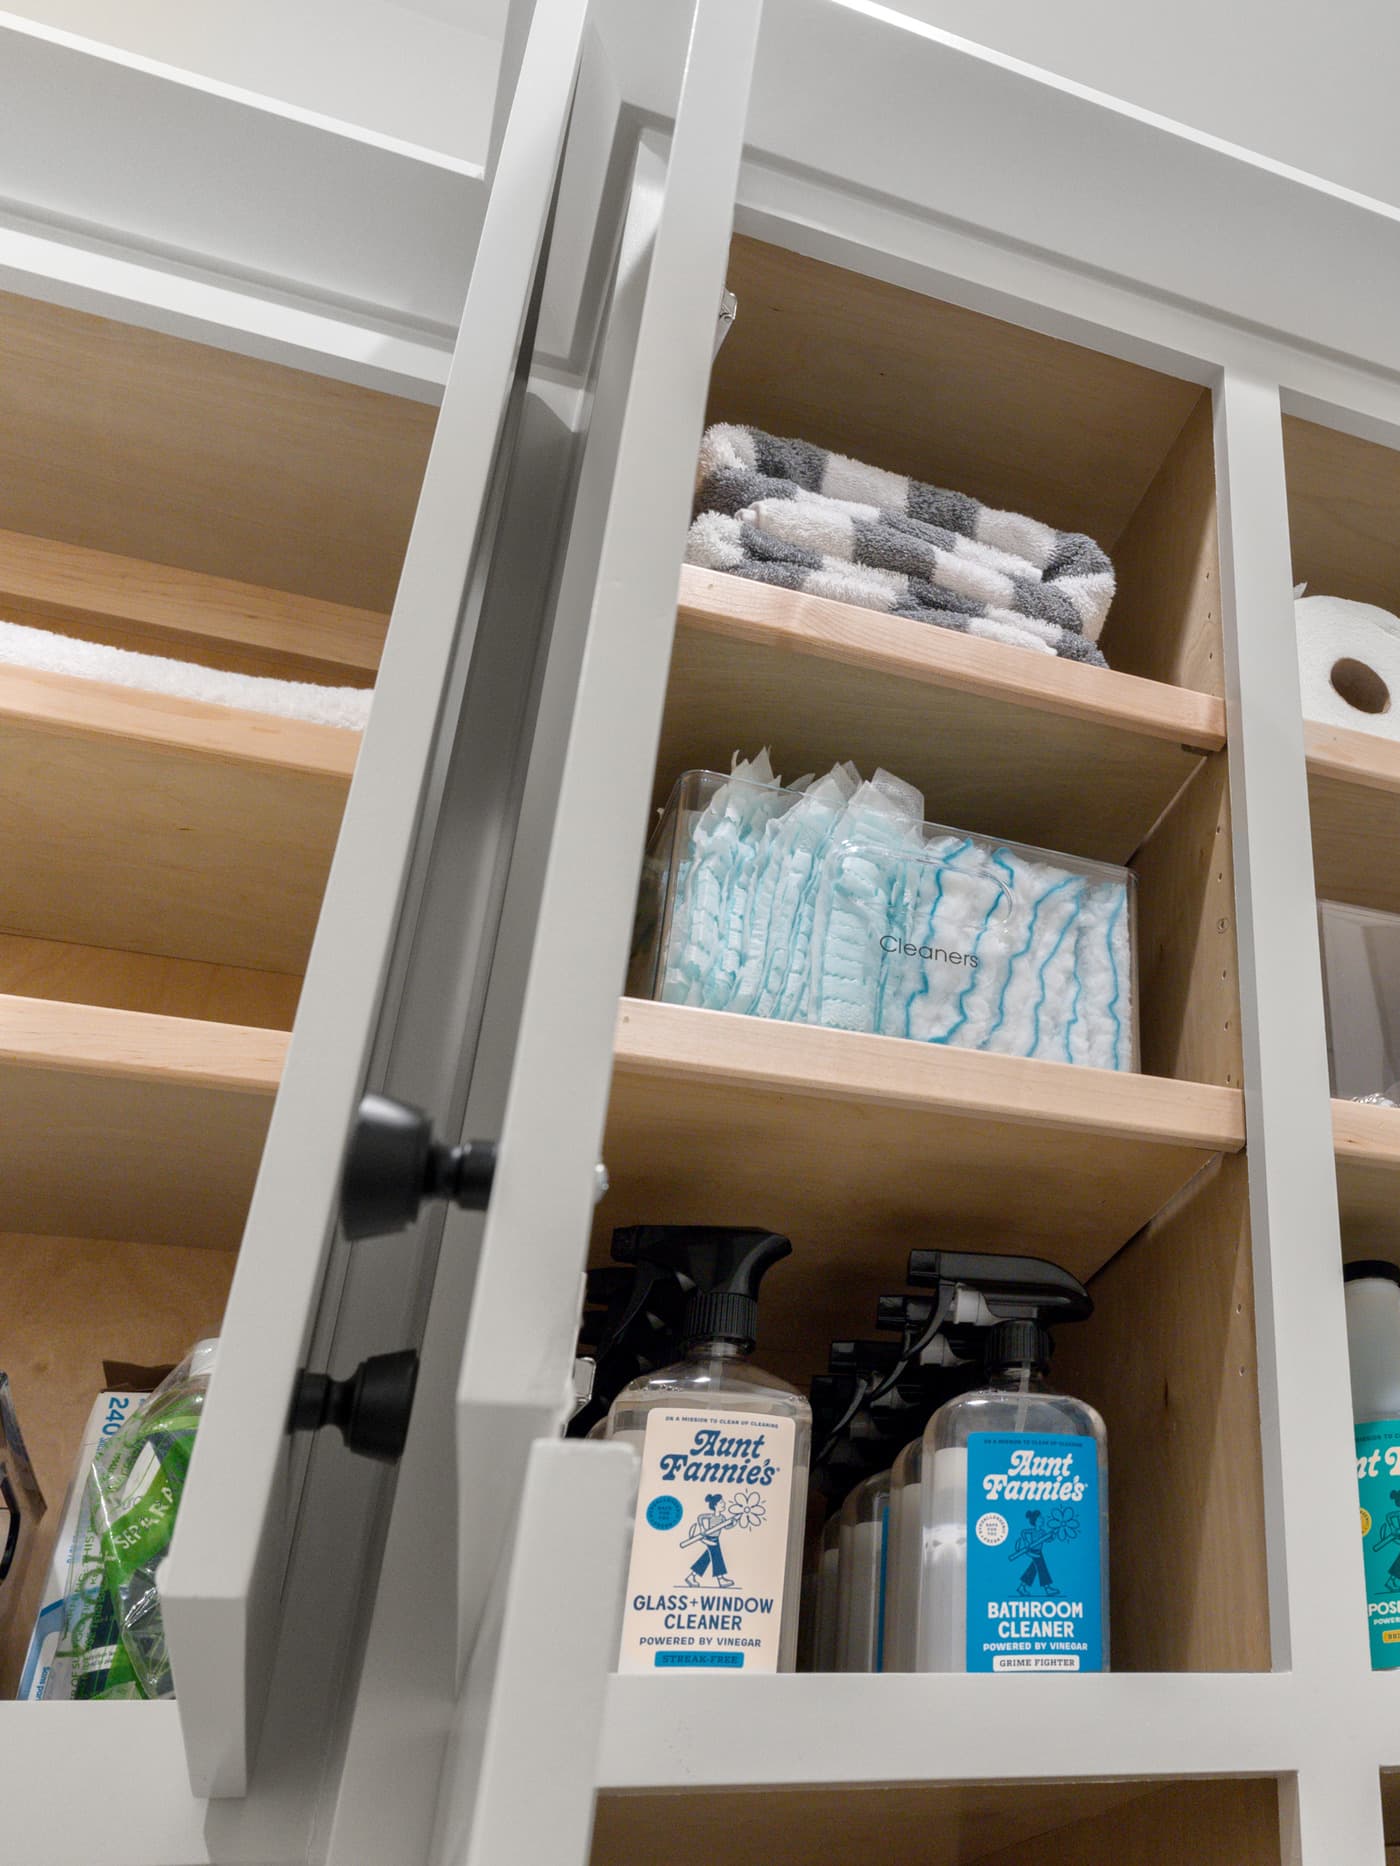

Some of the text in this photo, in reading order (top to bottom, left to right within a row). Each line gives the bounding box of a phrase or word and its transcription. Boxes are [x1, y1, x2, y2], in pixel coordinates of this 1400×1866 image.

[880, 935, 978, 968] Cleaners
[102, 1397, 129, 1436] 240
[690, 1429, 765, 1458] Aunt
[660, 1453, 776, 1486] Fannie's
[1008, 1449, 1073, 1477] Aunt
[983, 1474, 1085, 1501] Fannie's
[987, 1601, 1083, 1618] BATHROOM
[664, 1614, 742, 1630] CLEANER
[998, 1621, 1074, 1638] CLEANER
[639, 1637, 761, 1647] POWERED BY VINEGAR
[983, 1642, 1088, 1652] POWERED BY VINEGAR
[662, 1654, 738, 1664] STREAK-FREE
[1000, 1658, 1075, 1667] GRIME FIGHTER
